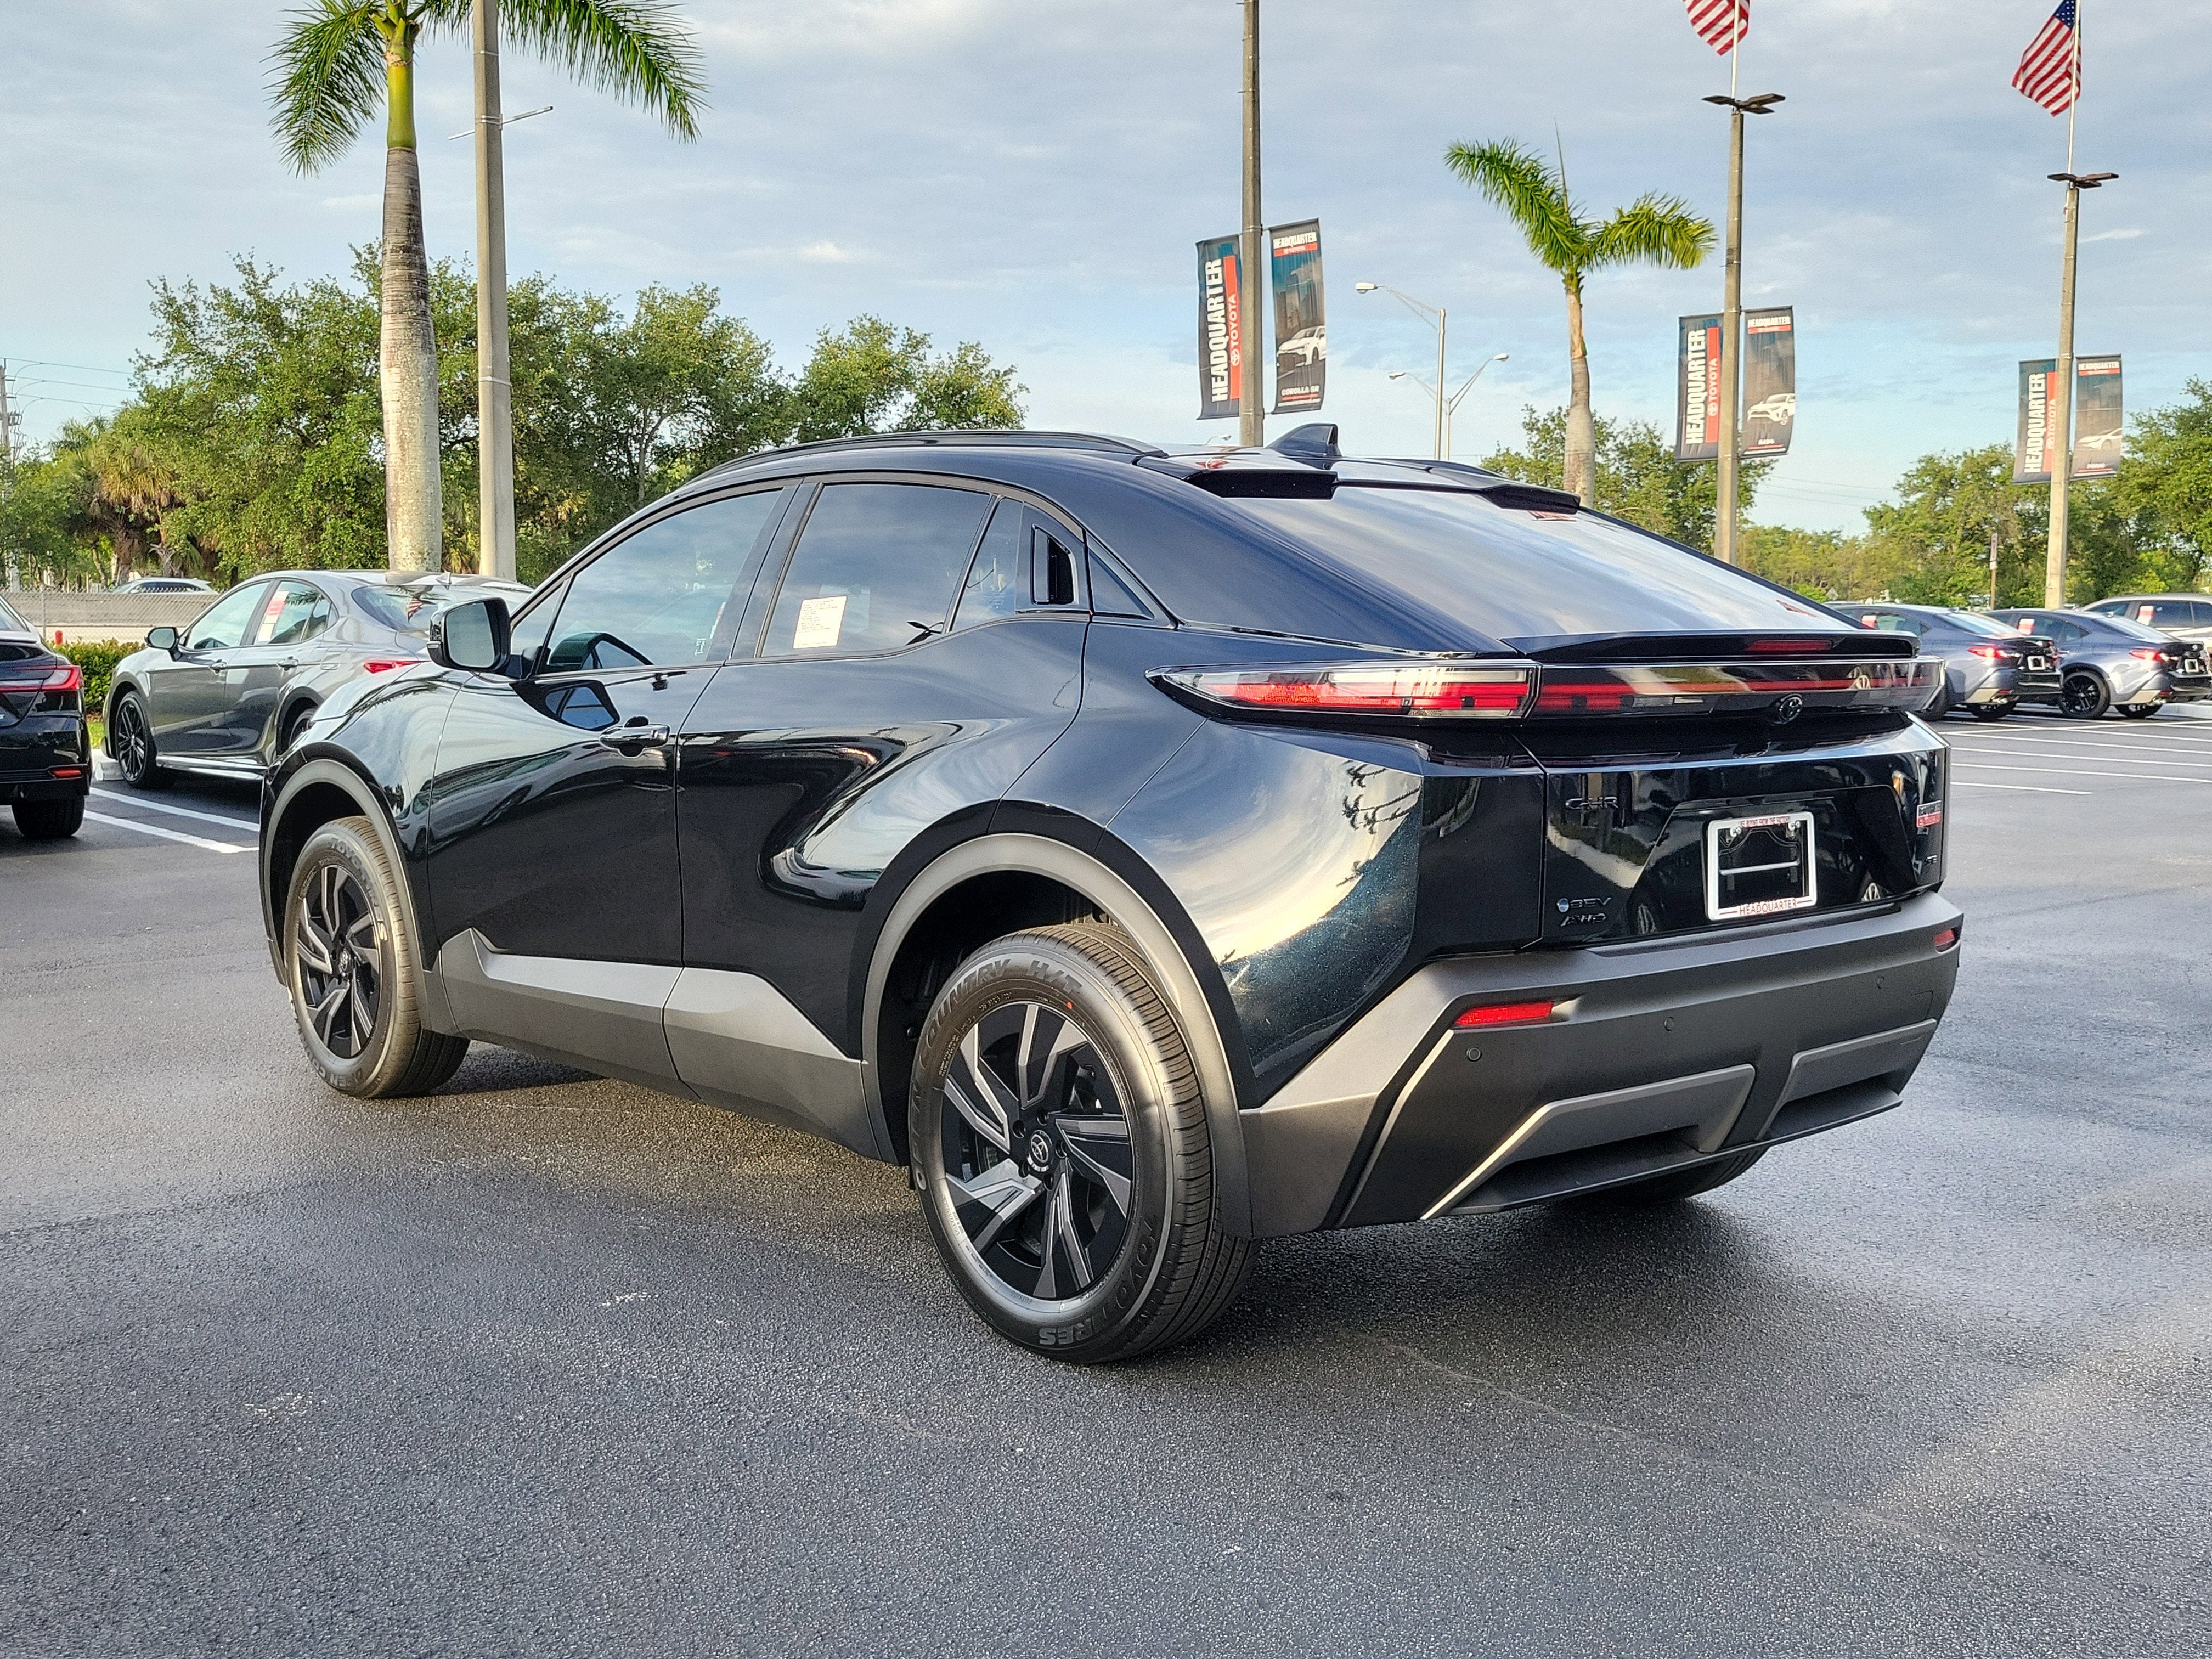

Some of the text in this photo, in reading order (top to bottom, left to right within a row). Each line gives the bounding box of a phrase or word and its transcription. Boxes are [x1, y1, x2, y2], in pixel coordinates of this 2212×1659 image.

[1273, 232, 1317, 249] HEADQUARTER
[1205, 258, 1229, 402] HEADQUARTER
[1227, 294, 1240, 348] TOYOTA
[1685, 329, 1707, 444] HEADQUARTER
[1708, 358, 1718, 403] TOYOTA
[2023, 373, 2047, 473] HEADQUARTER
[2047, 398, 2057, 441] TOYOTA
[330, 837, 362, 868] TOYO
[1560, 913, 1606, 927] AWD
[1570, 897, 1612, 908] BEV
[1739, 899, 1797, 916] HEADQUARTER
[918, 958, 1011, 1070] COUNTRY
[1025, 960, 1083, 995] H/T
